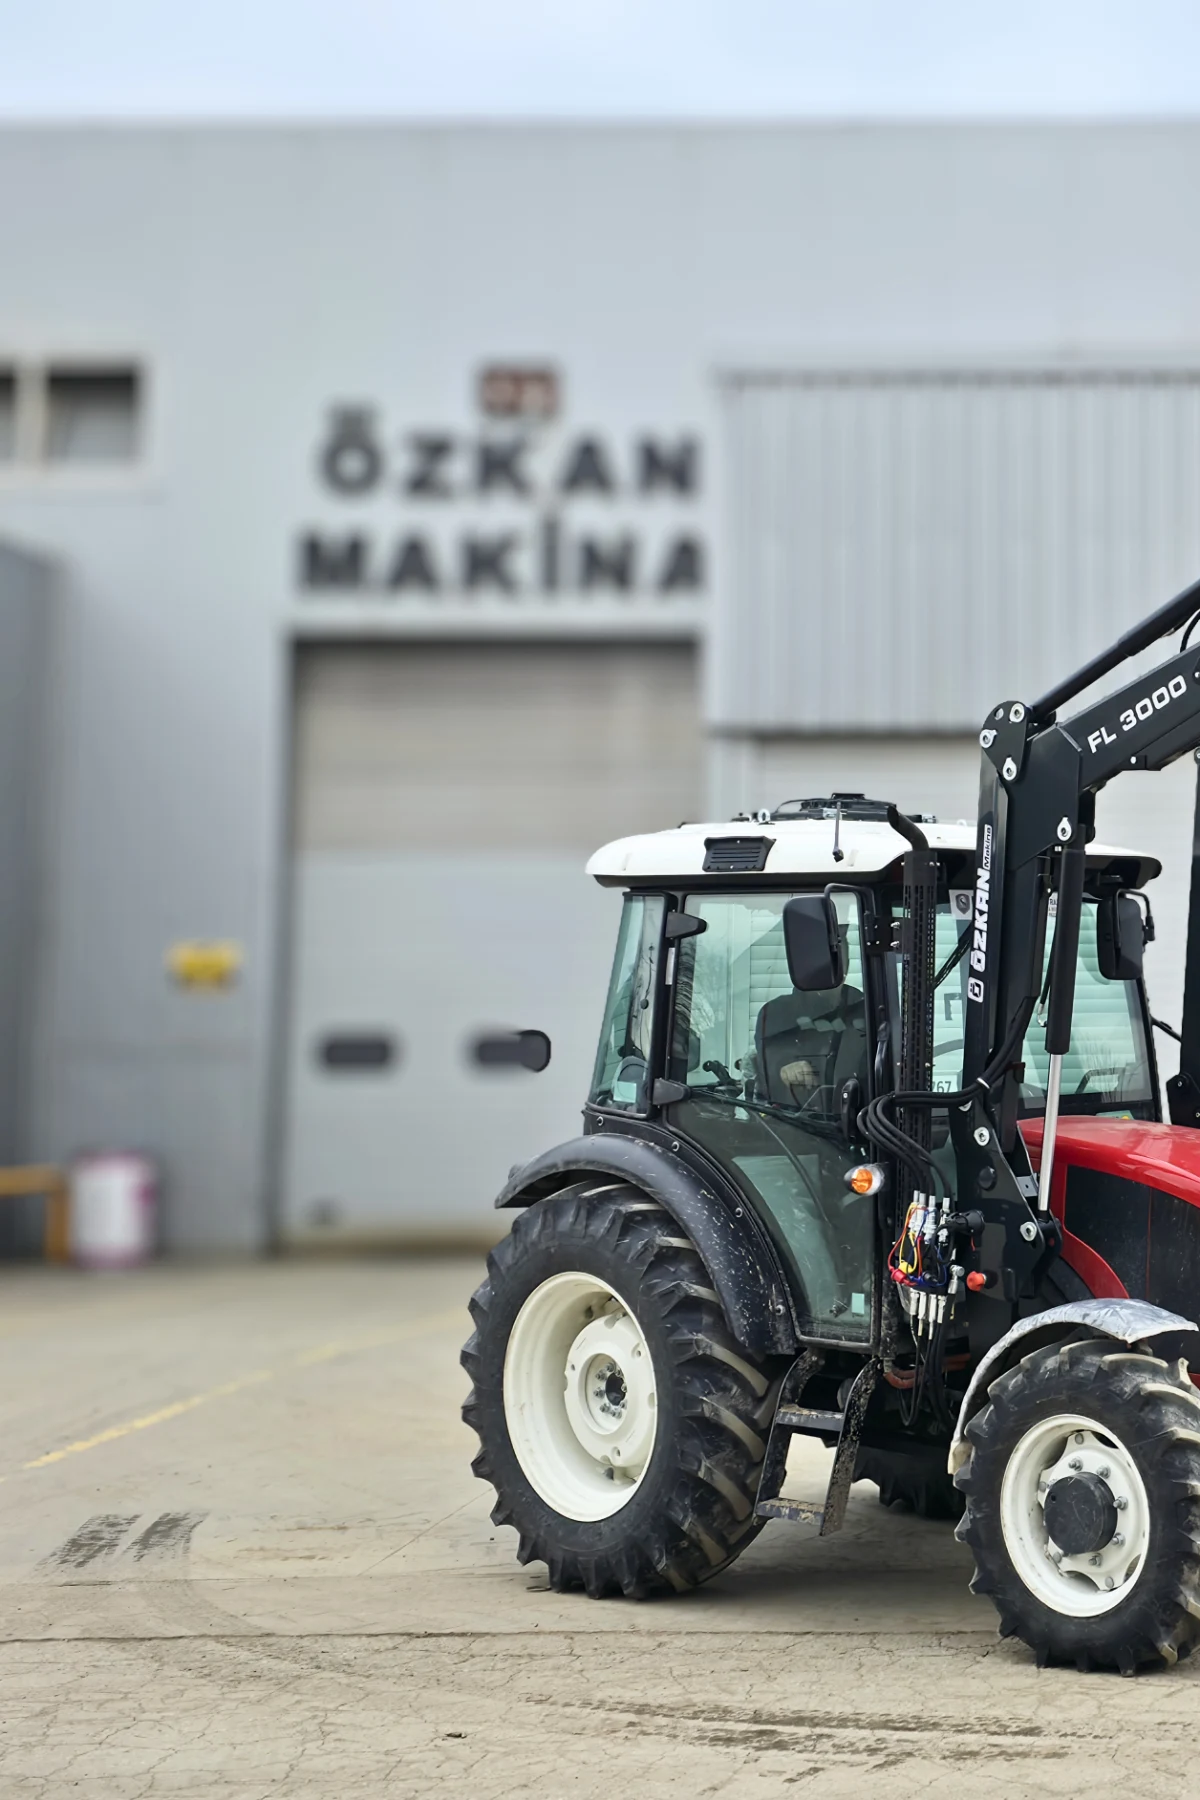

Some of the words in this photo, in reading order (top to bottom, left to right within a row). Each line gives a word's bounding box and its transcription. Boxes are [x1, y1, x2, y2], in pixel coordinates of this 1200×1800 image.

[321, 400, 701, 495] ÖZKAN
[299, 513, 706, 593] MAKİNA
[1087, 726, 1117, 754] FL
[1119, 674, 1187, 732] 3000
[970, 867, 991, 973] ÖZKAN
